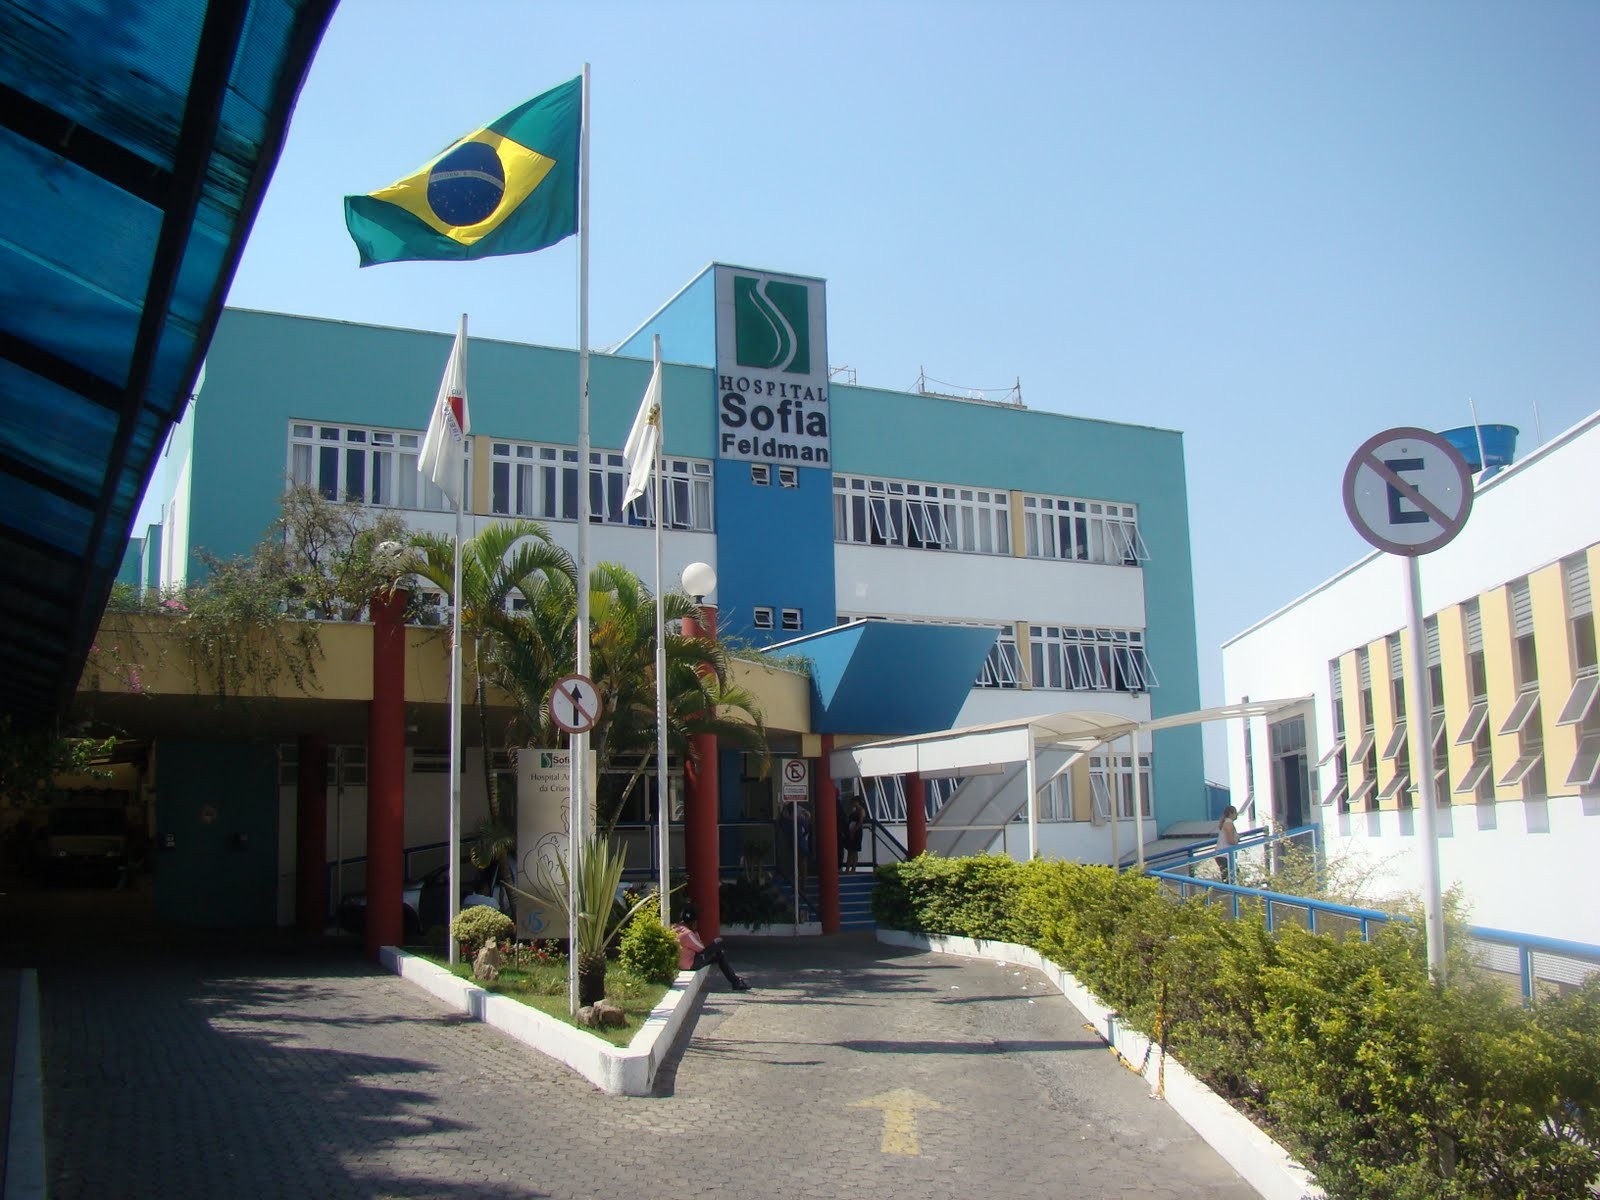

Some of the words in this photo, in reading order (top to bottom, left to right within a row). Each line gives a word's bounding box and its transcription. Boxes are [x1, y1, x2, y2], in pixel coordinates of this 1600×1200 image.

[719, 375, 827, 402] HOSPITAL
[720, 392, 828, 438] Sofia
[721, 433, 829, 462] Feldman
[1384, 457, 1430, 524] E
[553, 756, 570, 764] Sofi
[530, 773, 560, 783] Hospital
[539, 784, 548, 792] da
